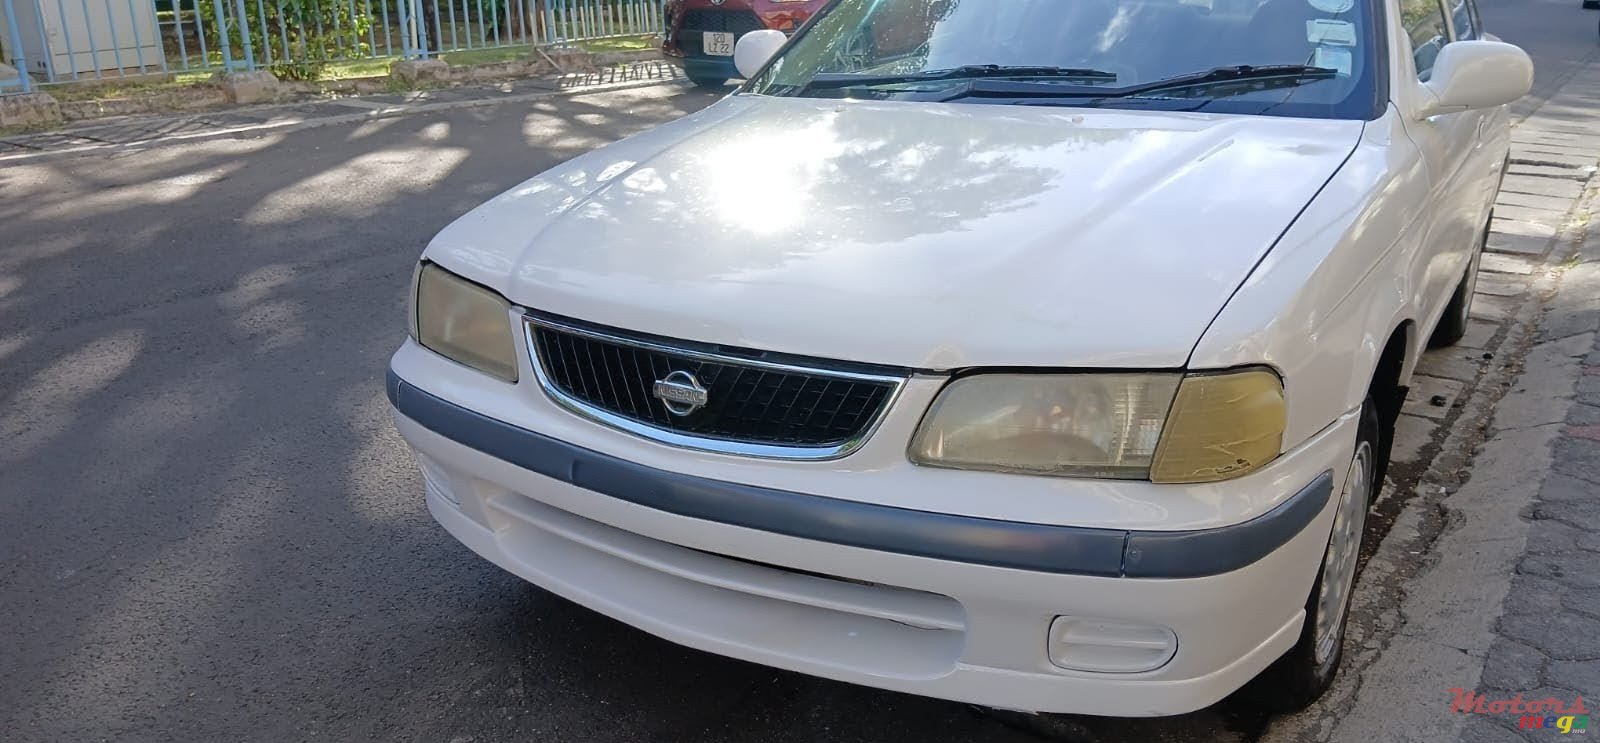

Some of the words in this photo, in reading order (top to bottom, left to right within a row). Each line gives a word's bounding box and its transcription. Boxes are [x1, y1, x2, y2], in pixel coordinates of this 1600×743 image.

[713, 33, 725, 43] 120
[720, 43, 729, 53] 22
[658, 384, 698, 402] NISSAN
